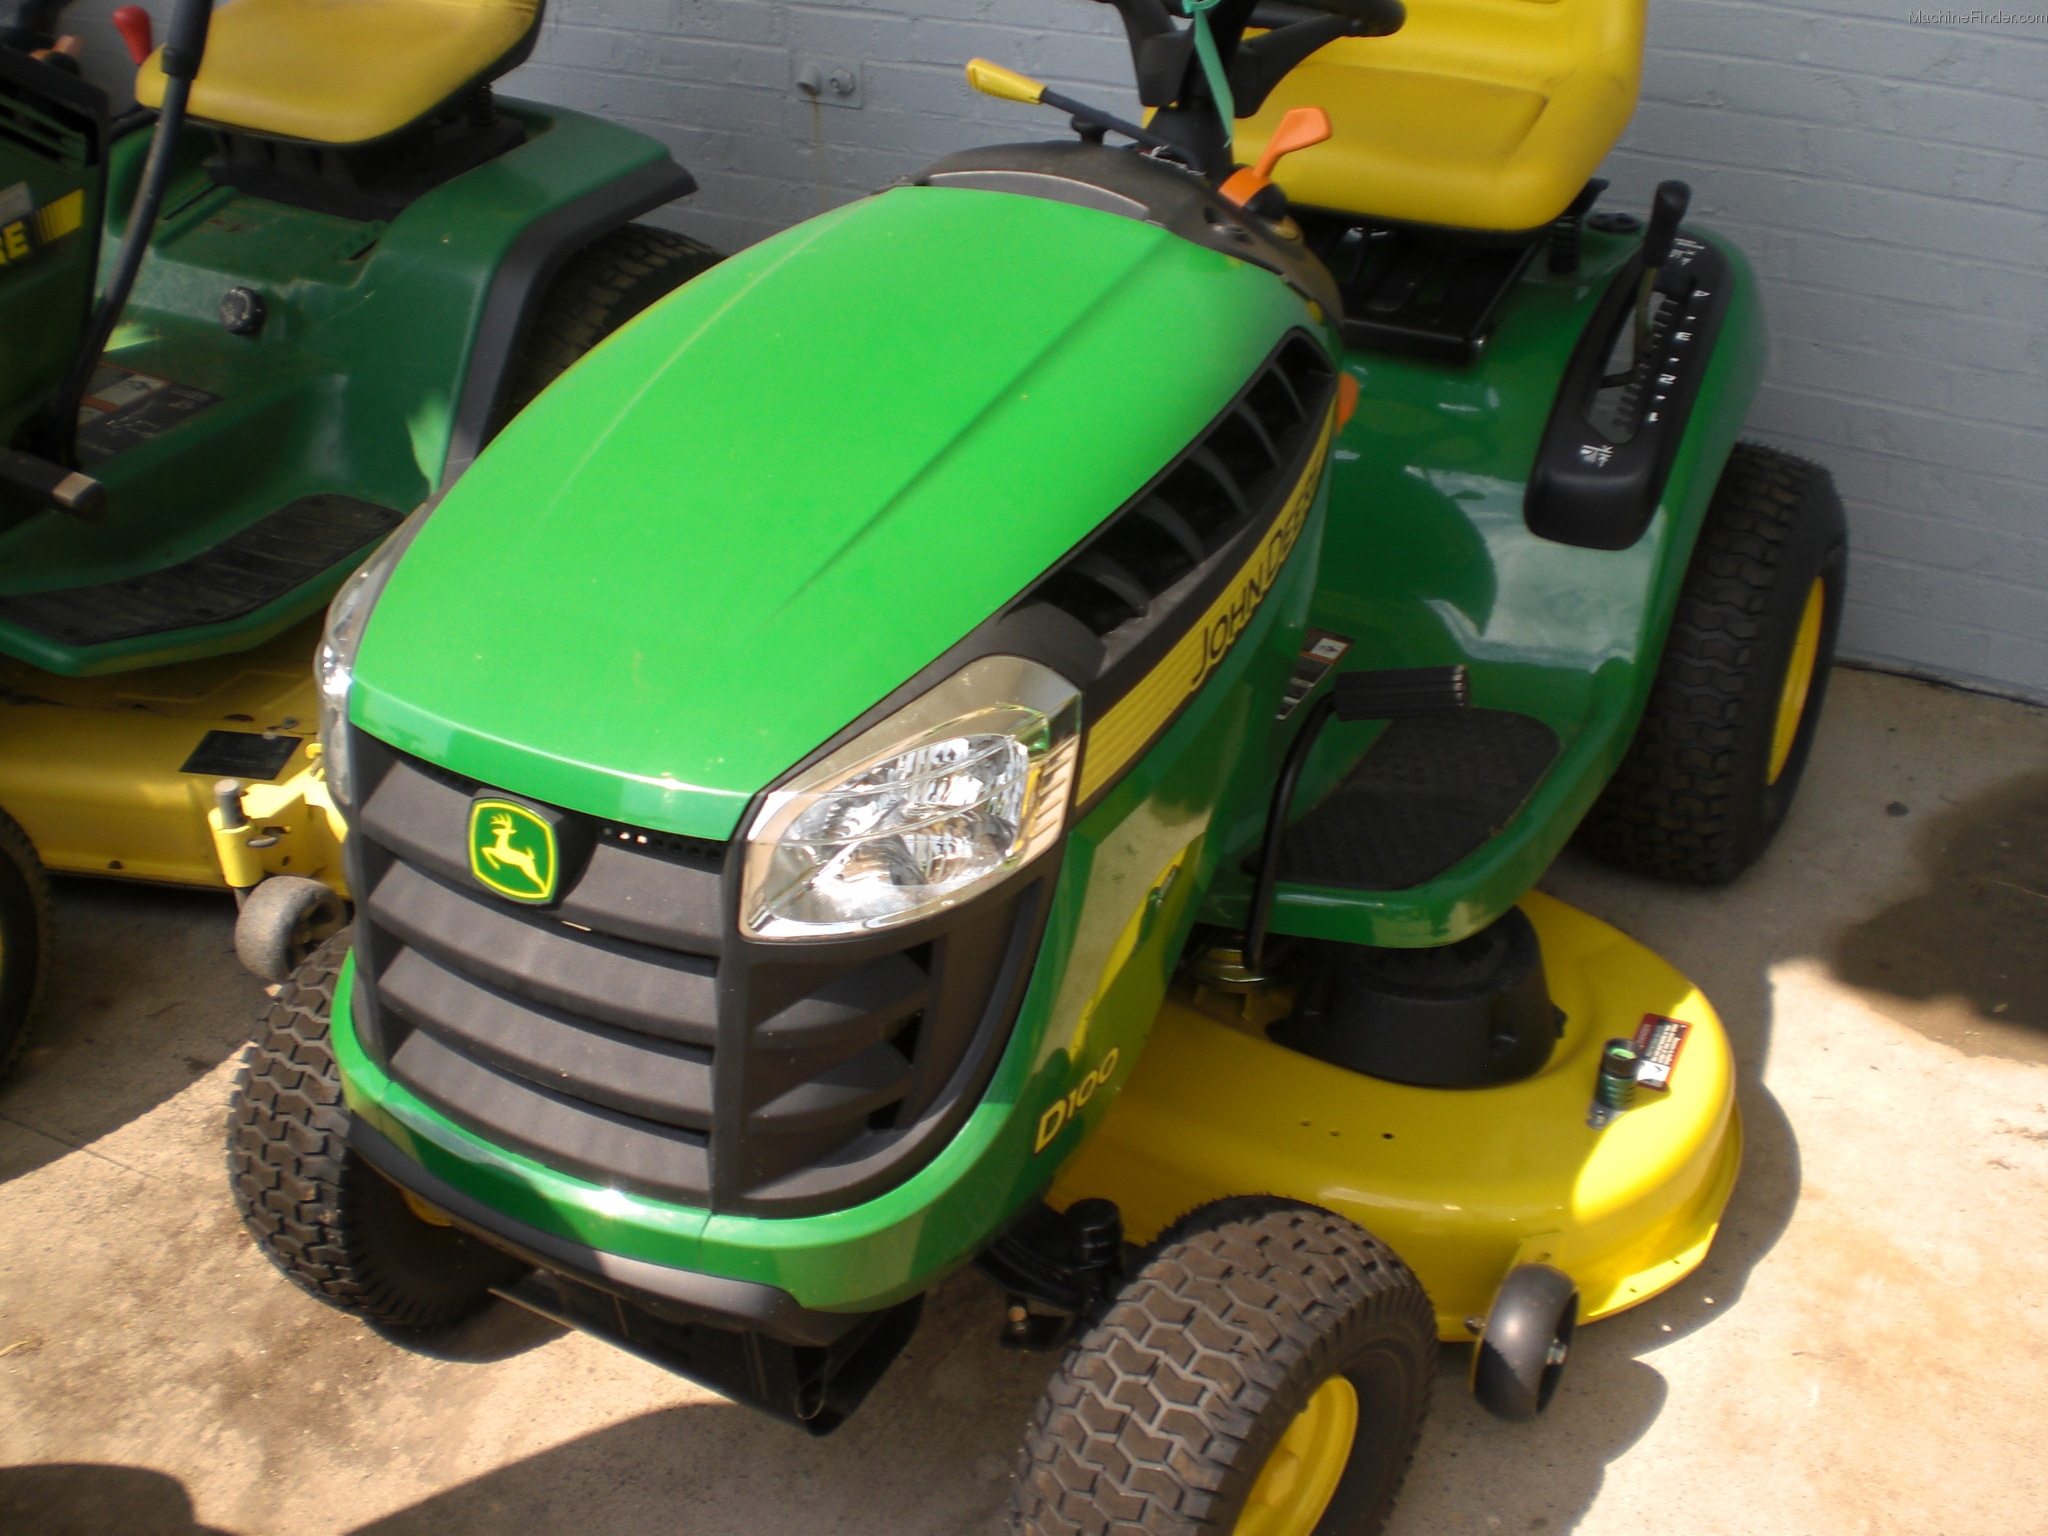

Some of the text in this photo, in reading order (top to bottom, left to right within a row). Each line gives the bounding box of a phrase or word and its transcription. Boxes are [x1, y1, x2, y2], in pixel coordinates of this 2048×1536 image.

[1658, 372, 1677, 385] 2
[1191, 563, 1266, 687] JOHN
[1034, 1047, 1119, 1154] D100
